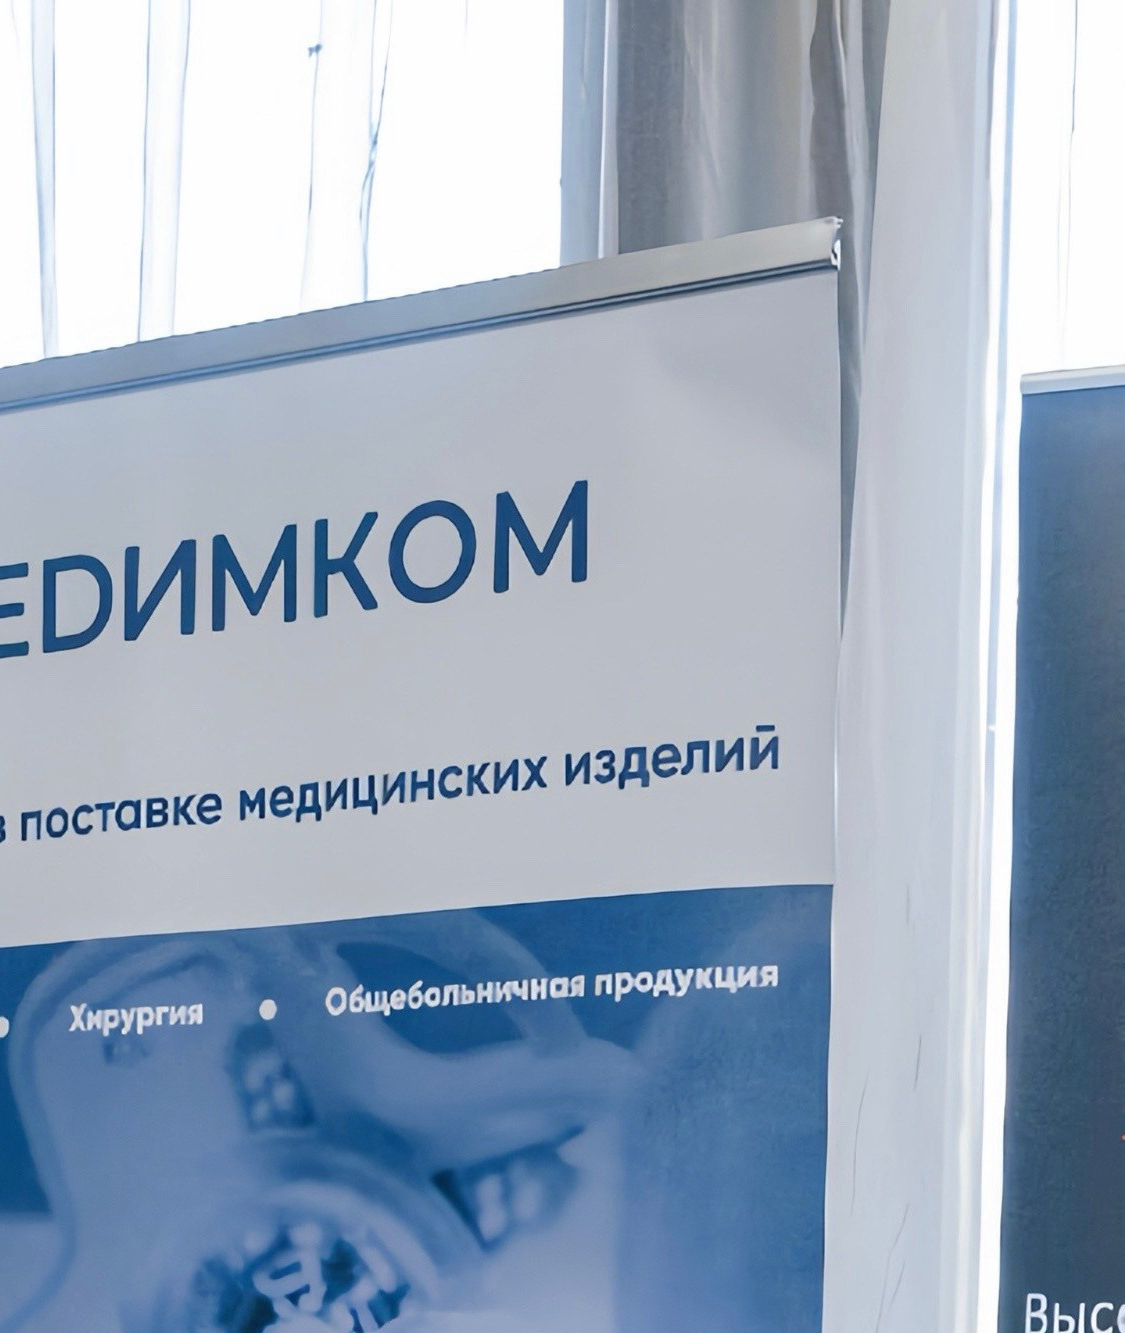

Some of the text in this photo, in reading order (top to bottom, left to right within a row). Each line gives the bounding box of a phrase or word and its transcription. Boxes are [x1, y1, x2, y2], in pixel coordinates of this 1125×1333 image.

[21, 793, 223, 842] поставке
[239, 756, 548, 824] медицинских
[565, 724, 780, 789] изделий
[69, 1001, 204, 1037] Хирургия
[325, 979, 586, 1017] Общебольничная
[594, 964, 779, 1003] продукция
